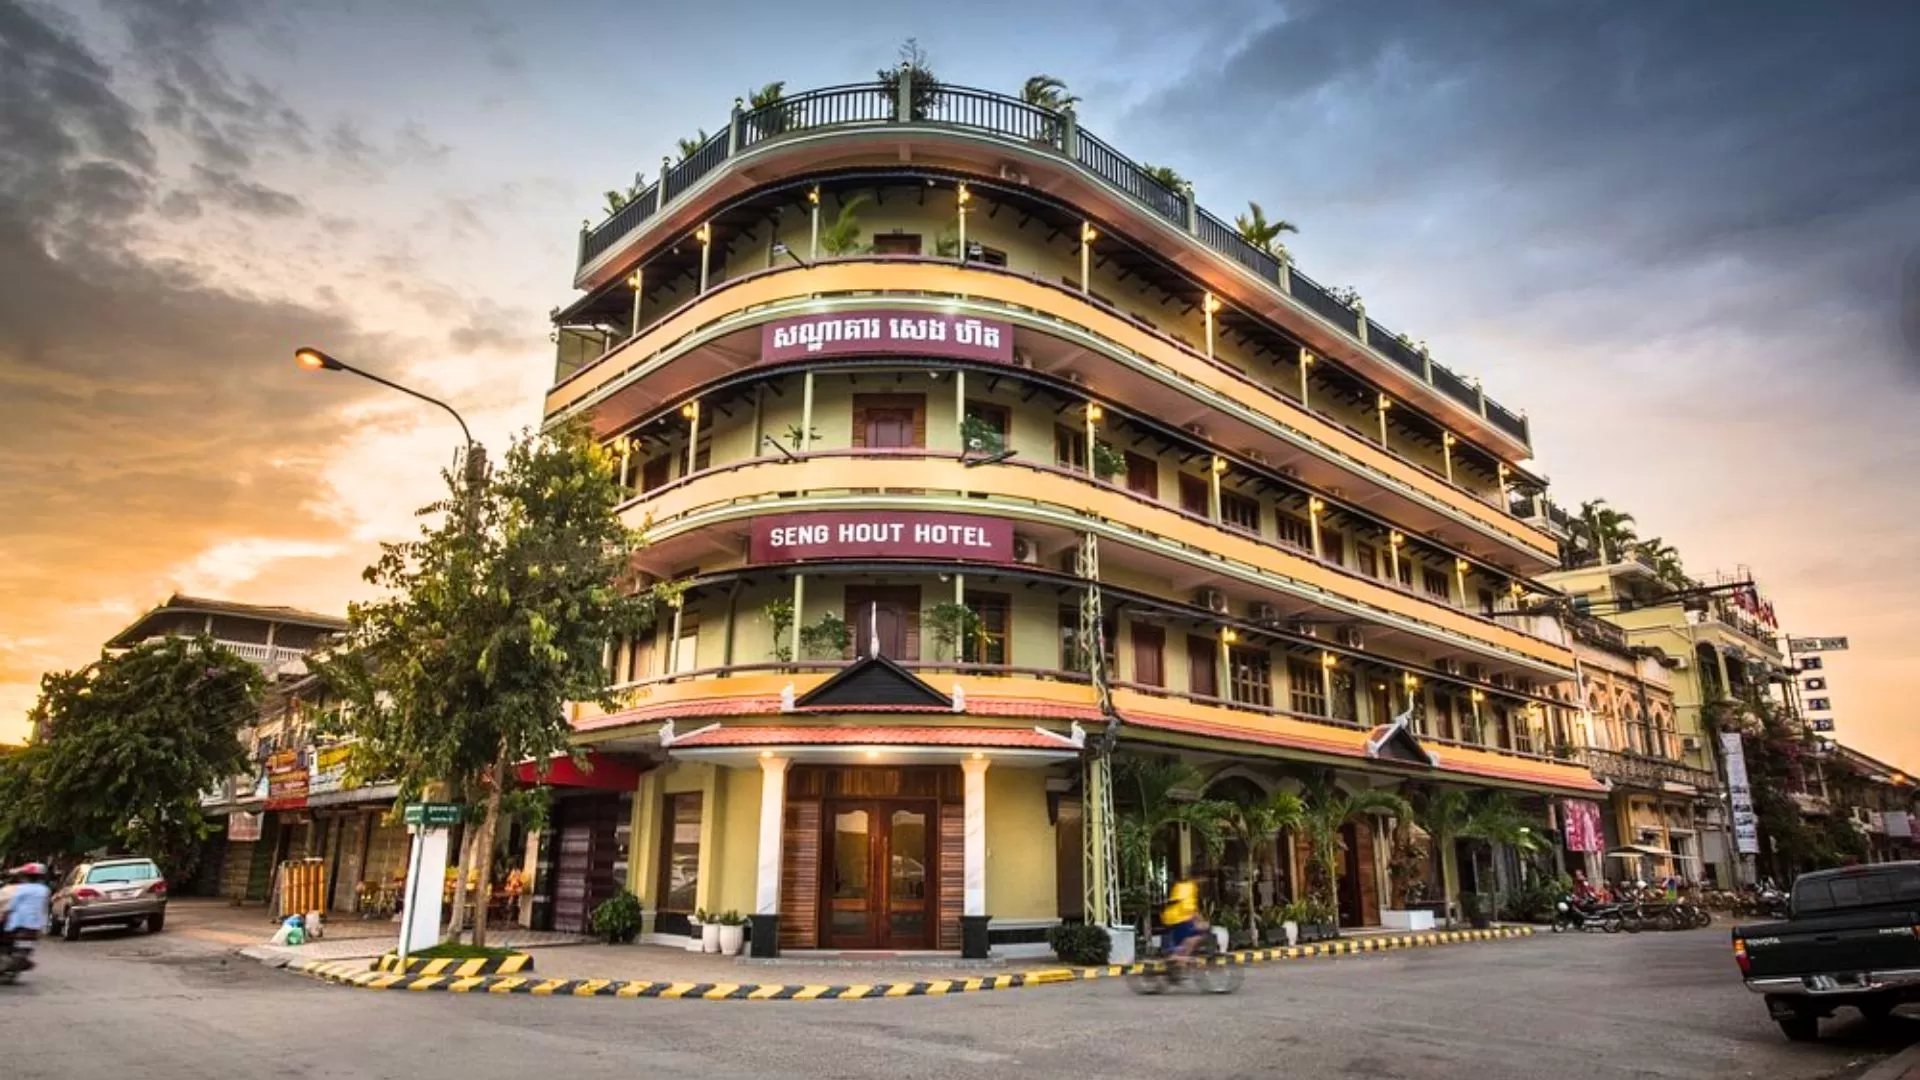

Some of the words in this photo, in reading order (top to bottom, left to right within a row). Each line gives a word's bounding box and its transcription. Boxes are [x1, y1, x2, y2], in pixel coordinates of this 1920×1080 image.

[889, 317, 946, 341] សេង
[770, 525, 829, 546] SENG
[838, 523, 905, 543] HOUT
[914, 524, 992, 547] HOTEL
